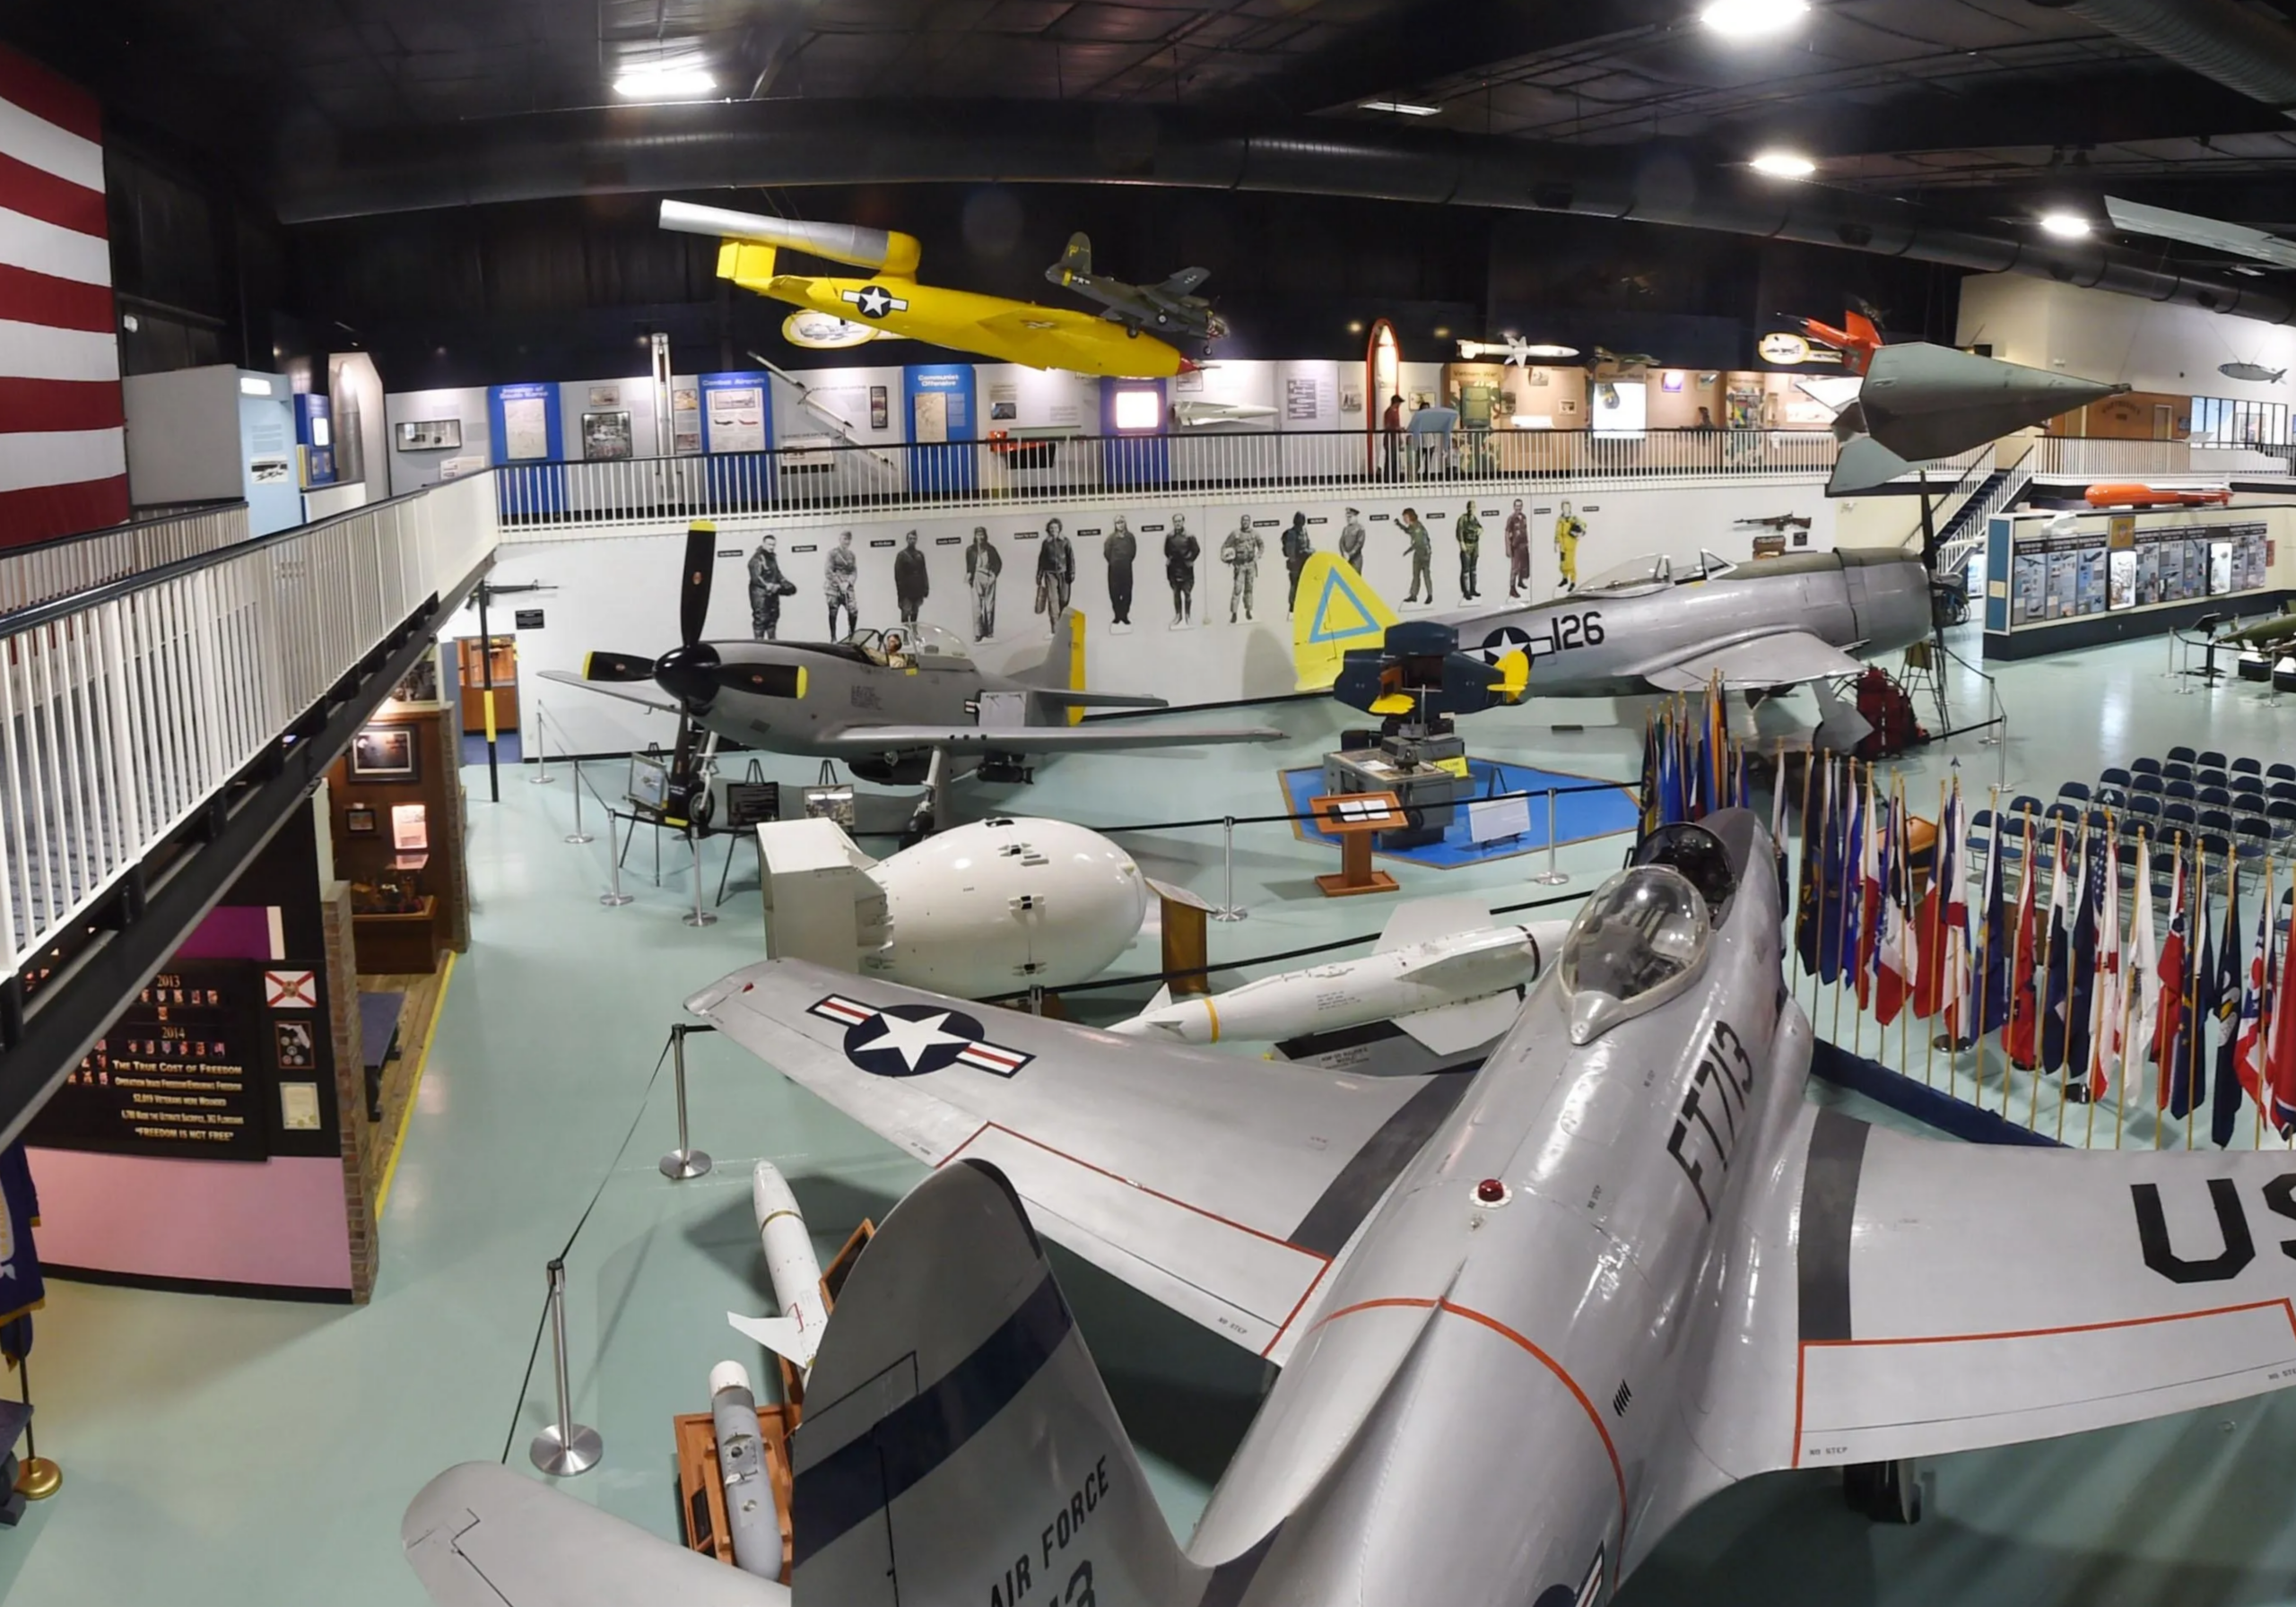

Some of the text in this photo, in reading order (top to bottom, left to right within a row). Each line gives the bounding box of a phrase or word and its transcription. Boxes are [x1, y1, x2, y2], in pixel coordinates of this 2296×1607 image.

[1552, 612, 1605, 651] 126
[157, 975, 180, 987] 2013
[161, 1027, 186, 1038] 2014
[178, 1130, 187, 1139] IS
[189, 1130, 206, 1139] NOT
[2129, 1173, 2296, 1284] U
[1218, 1316, 1248, 1334] NO STEP
[1825, 1446, 1848, 1455] STEP
[991, 1553, 1031, 1607] AIR
[1041, 1454, 1109, 1570] FORCE
